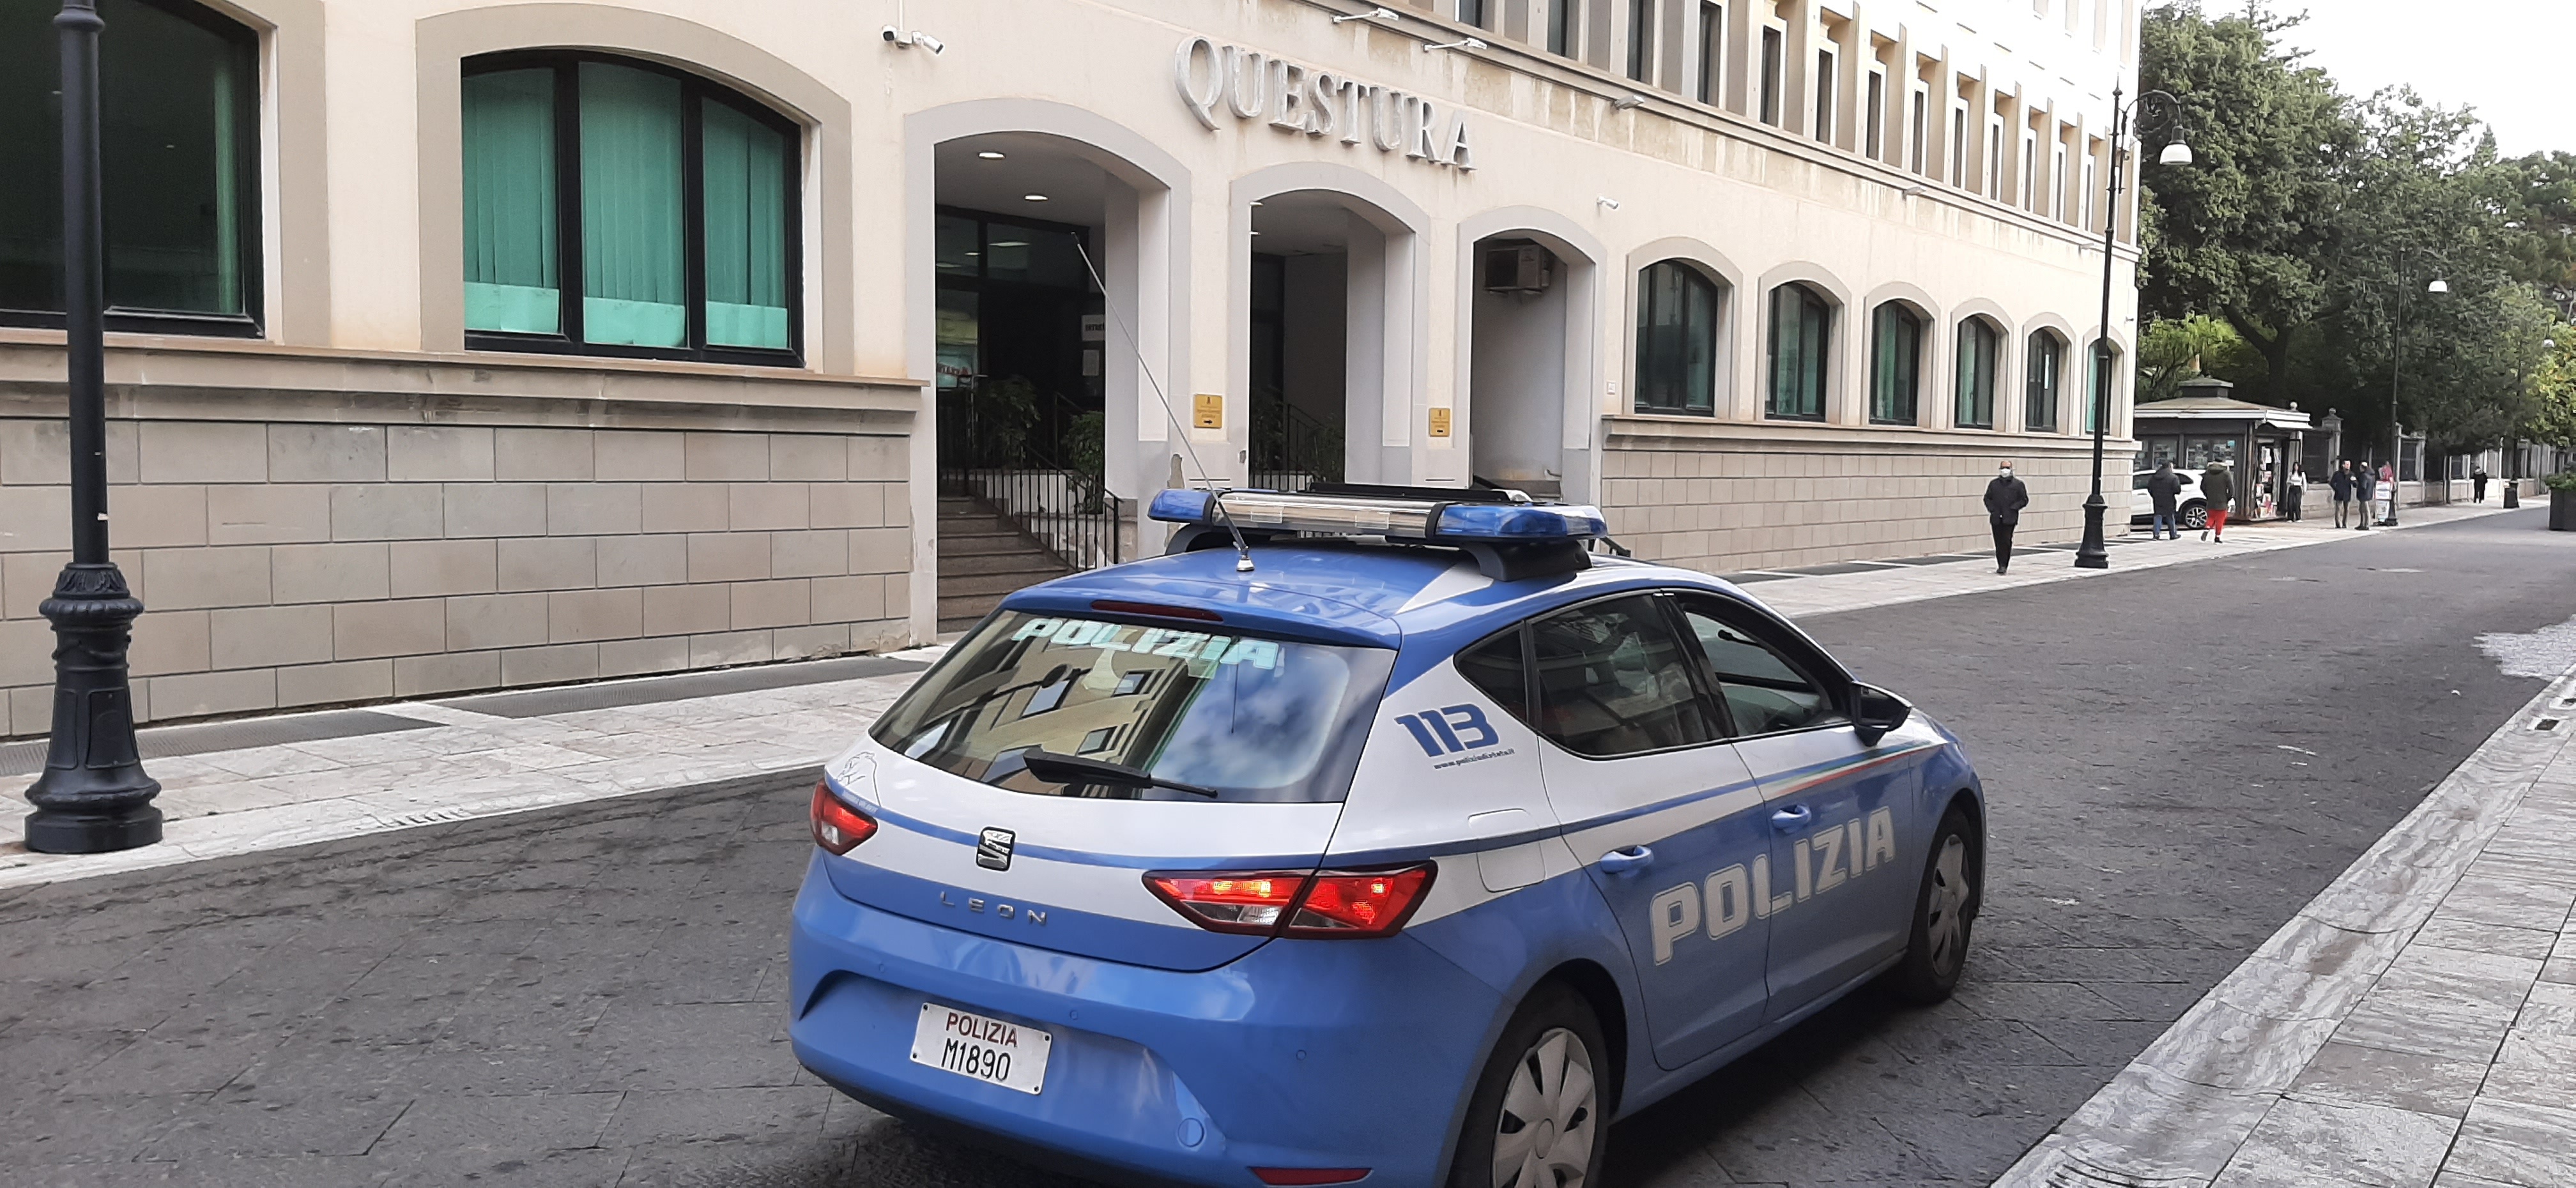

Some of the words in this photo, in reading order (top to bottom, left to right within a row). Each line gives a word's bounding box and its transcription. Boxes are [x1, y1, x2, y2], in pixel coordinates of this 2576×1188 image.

[1174, 35, 1477, 172] QUESTURA
[1013, 618, 1279, 669] POLIZIA
[1394, 703, 1499, 758] 113
[940, 890, 1047, 925] LEON
[1650, 805, 1896, 966] POLIZIA
[946, 1012, 1018, 1048] POLIZIA
[941, 1037, 1011, 1082] M1890
